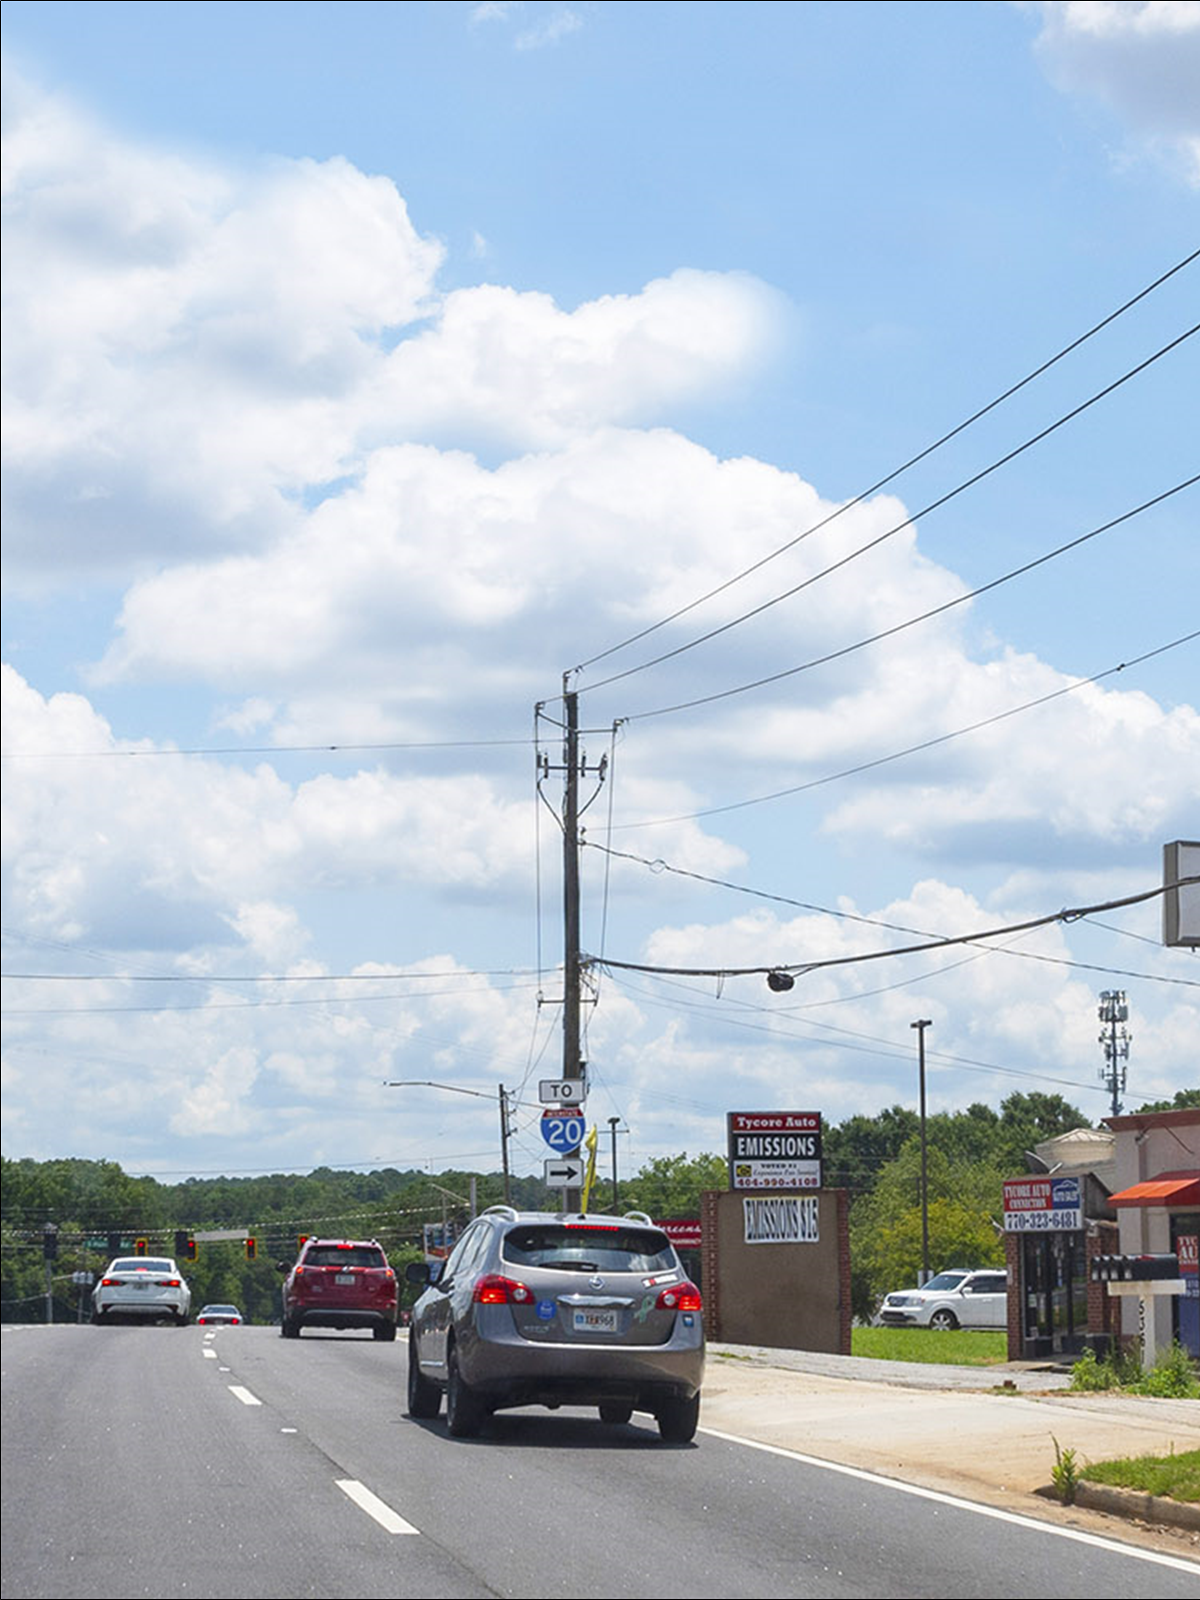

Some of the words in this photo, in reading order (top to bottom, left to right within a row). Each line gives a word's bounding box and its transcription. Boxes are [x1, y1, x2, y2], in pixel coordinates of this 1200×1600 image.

[550, 1084, 572, 1098] TO
[737, 1117, 783, 1129] Tycore
[785, 1116, 816, 1127] Auto
[549, 1121, 580, 1144] 20
[737, 1137, 815, 1156] EMISSIONS
[737, 1177, 818, 1187] 404-990-4108
[744, 1199, 798, 1239] EMISSIONS
[1007, 1211, 1077, 1229] 770-323-6481
